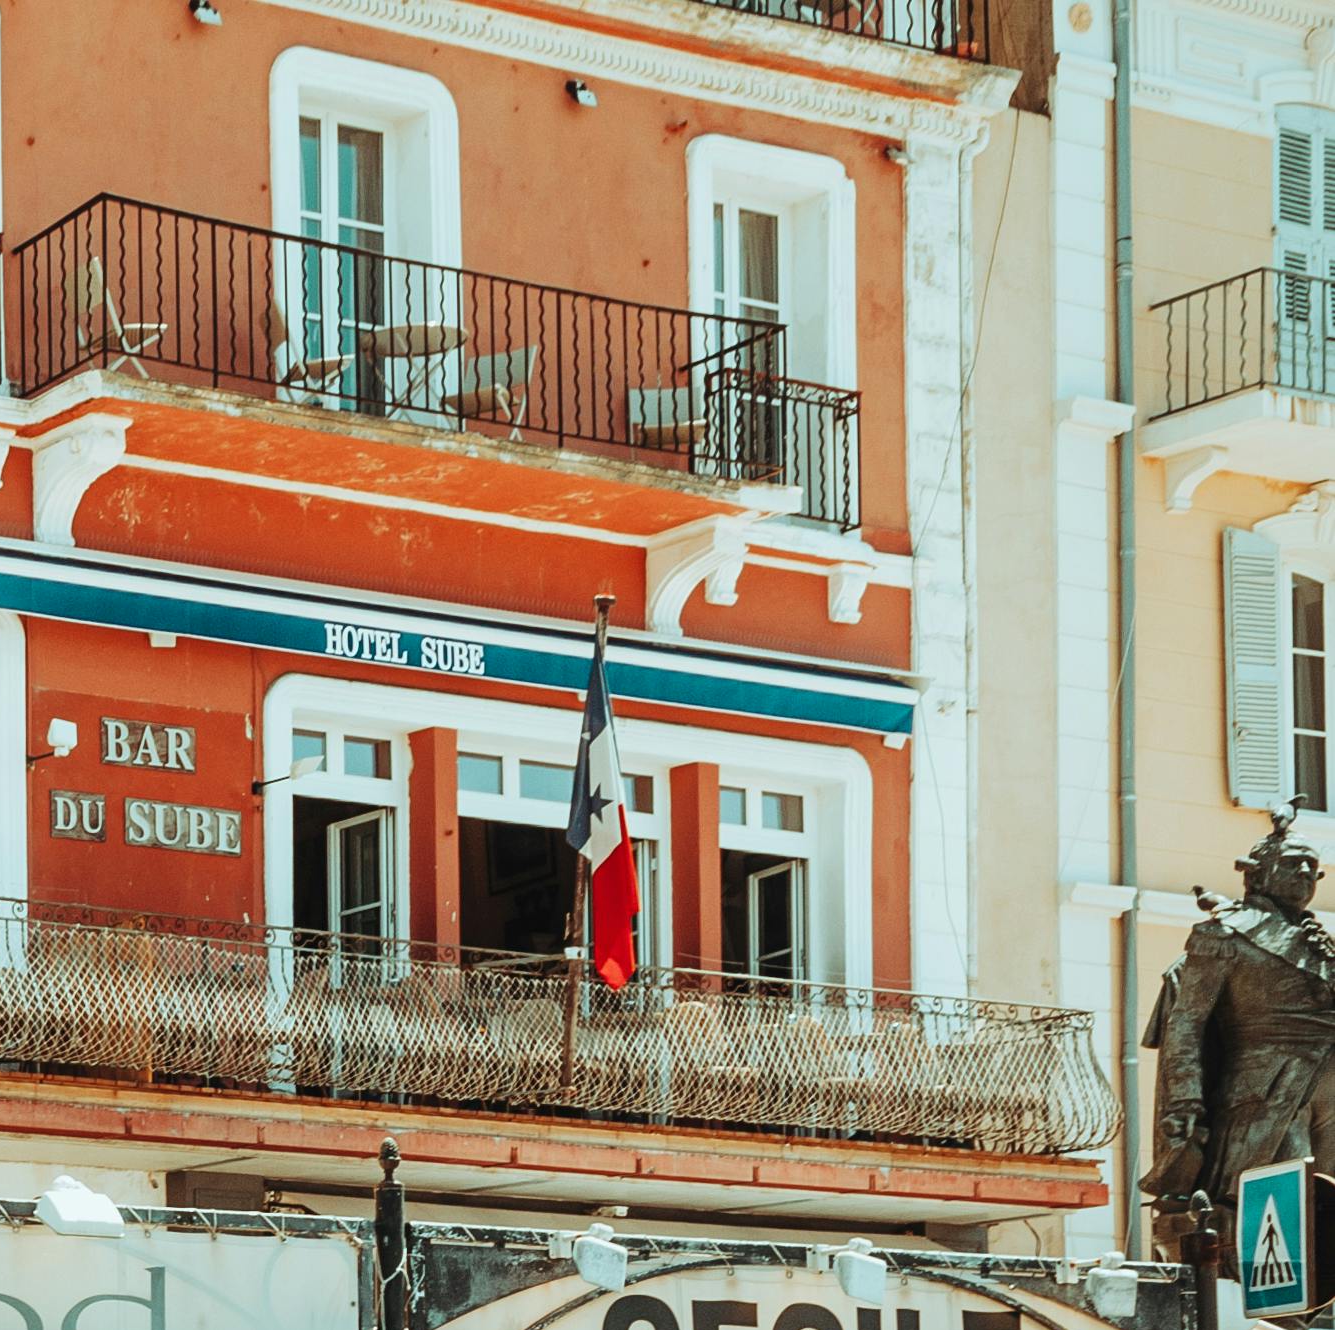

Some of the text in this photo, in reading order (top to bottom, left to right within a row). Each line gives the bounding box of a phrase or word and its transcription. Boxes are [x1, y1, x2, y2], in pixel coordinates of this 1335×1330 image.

[324, 623, 485, 676] HOTEL SUBE
[103, 720, 195, 770] BAR
[55, 796, 241, 854] DU SUBE
